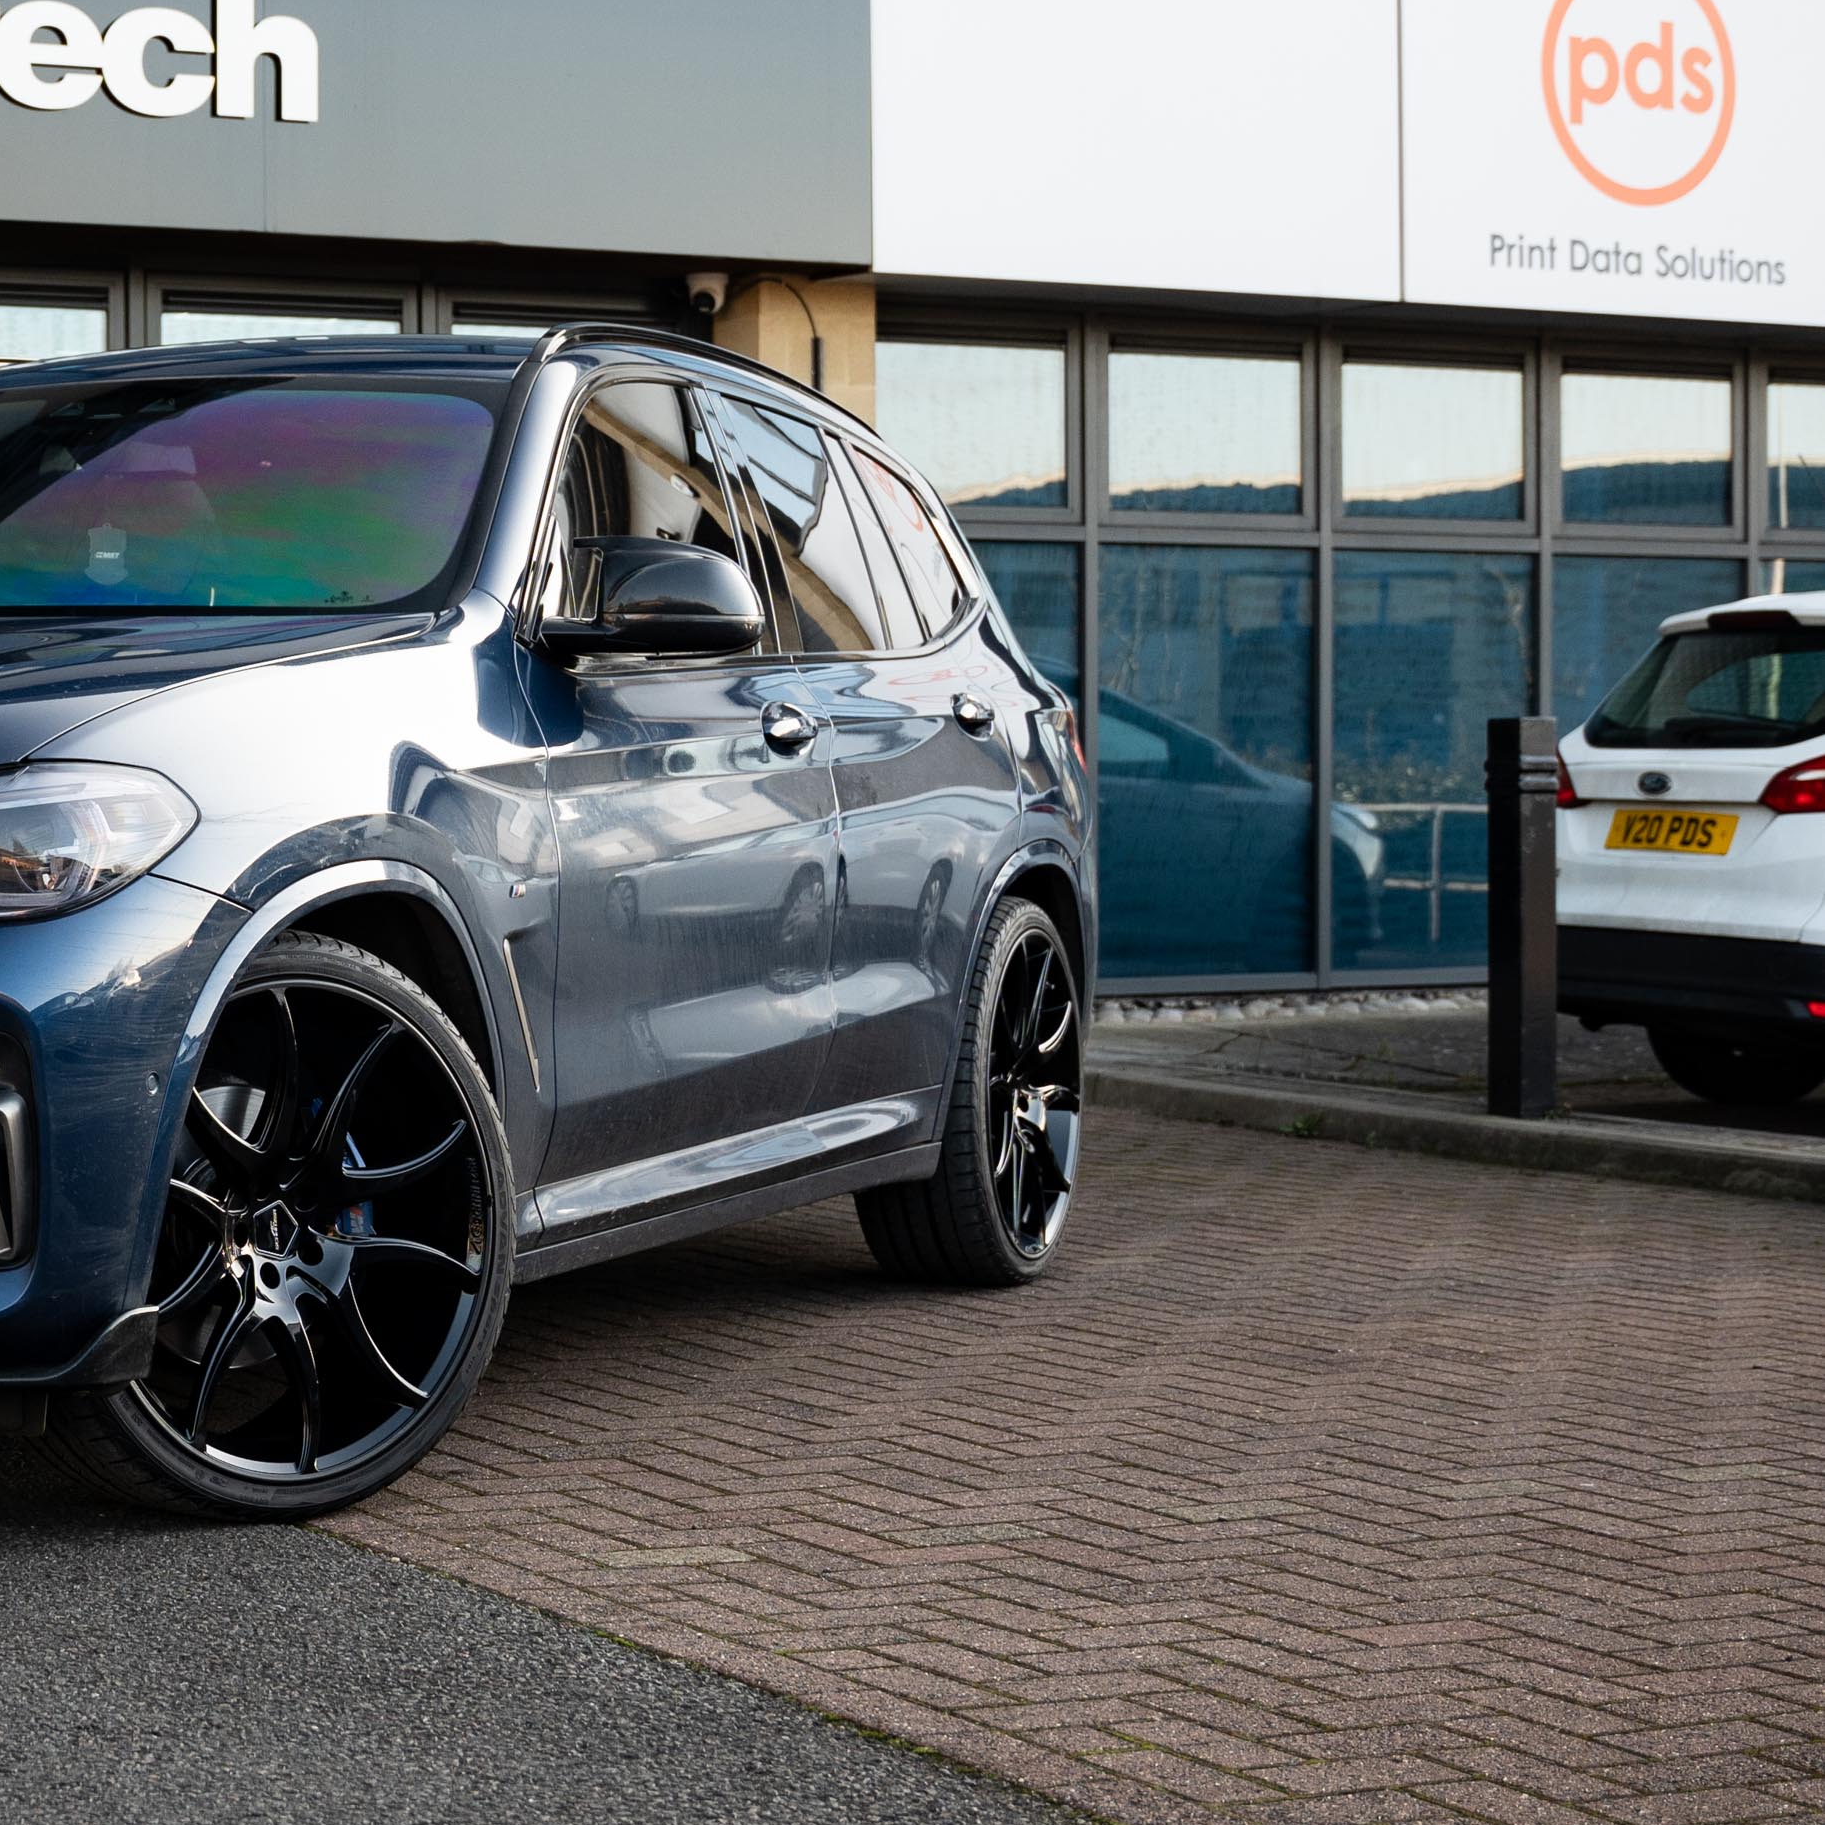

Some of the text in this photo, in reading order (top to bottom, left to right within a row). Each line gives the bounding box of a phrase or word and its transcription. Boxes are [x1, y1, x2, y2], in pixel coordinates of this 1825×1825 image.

[1568, 20, 1715, 125] pds
[1489, 233, 1787, 287] Print Data Solutions
[1664, 815, 1716, 848] PDS
